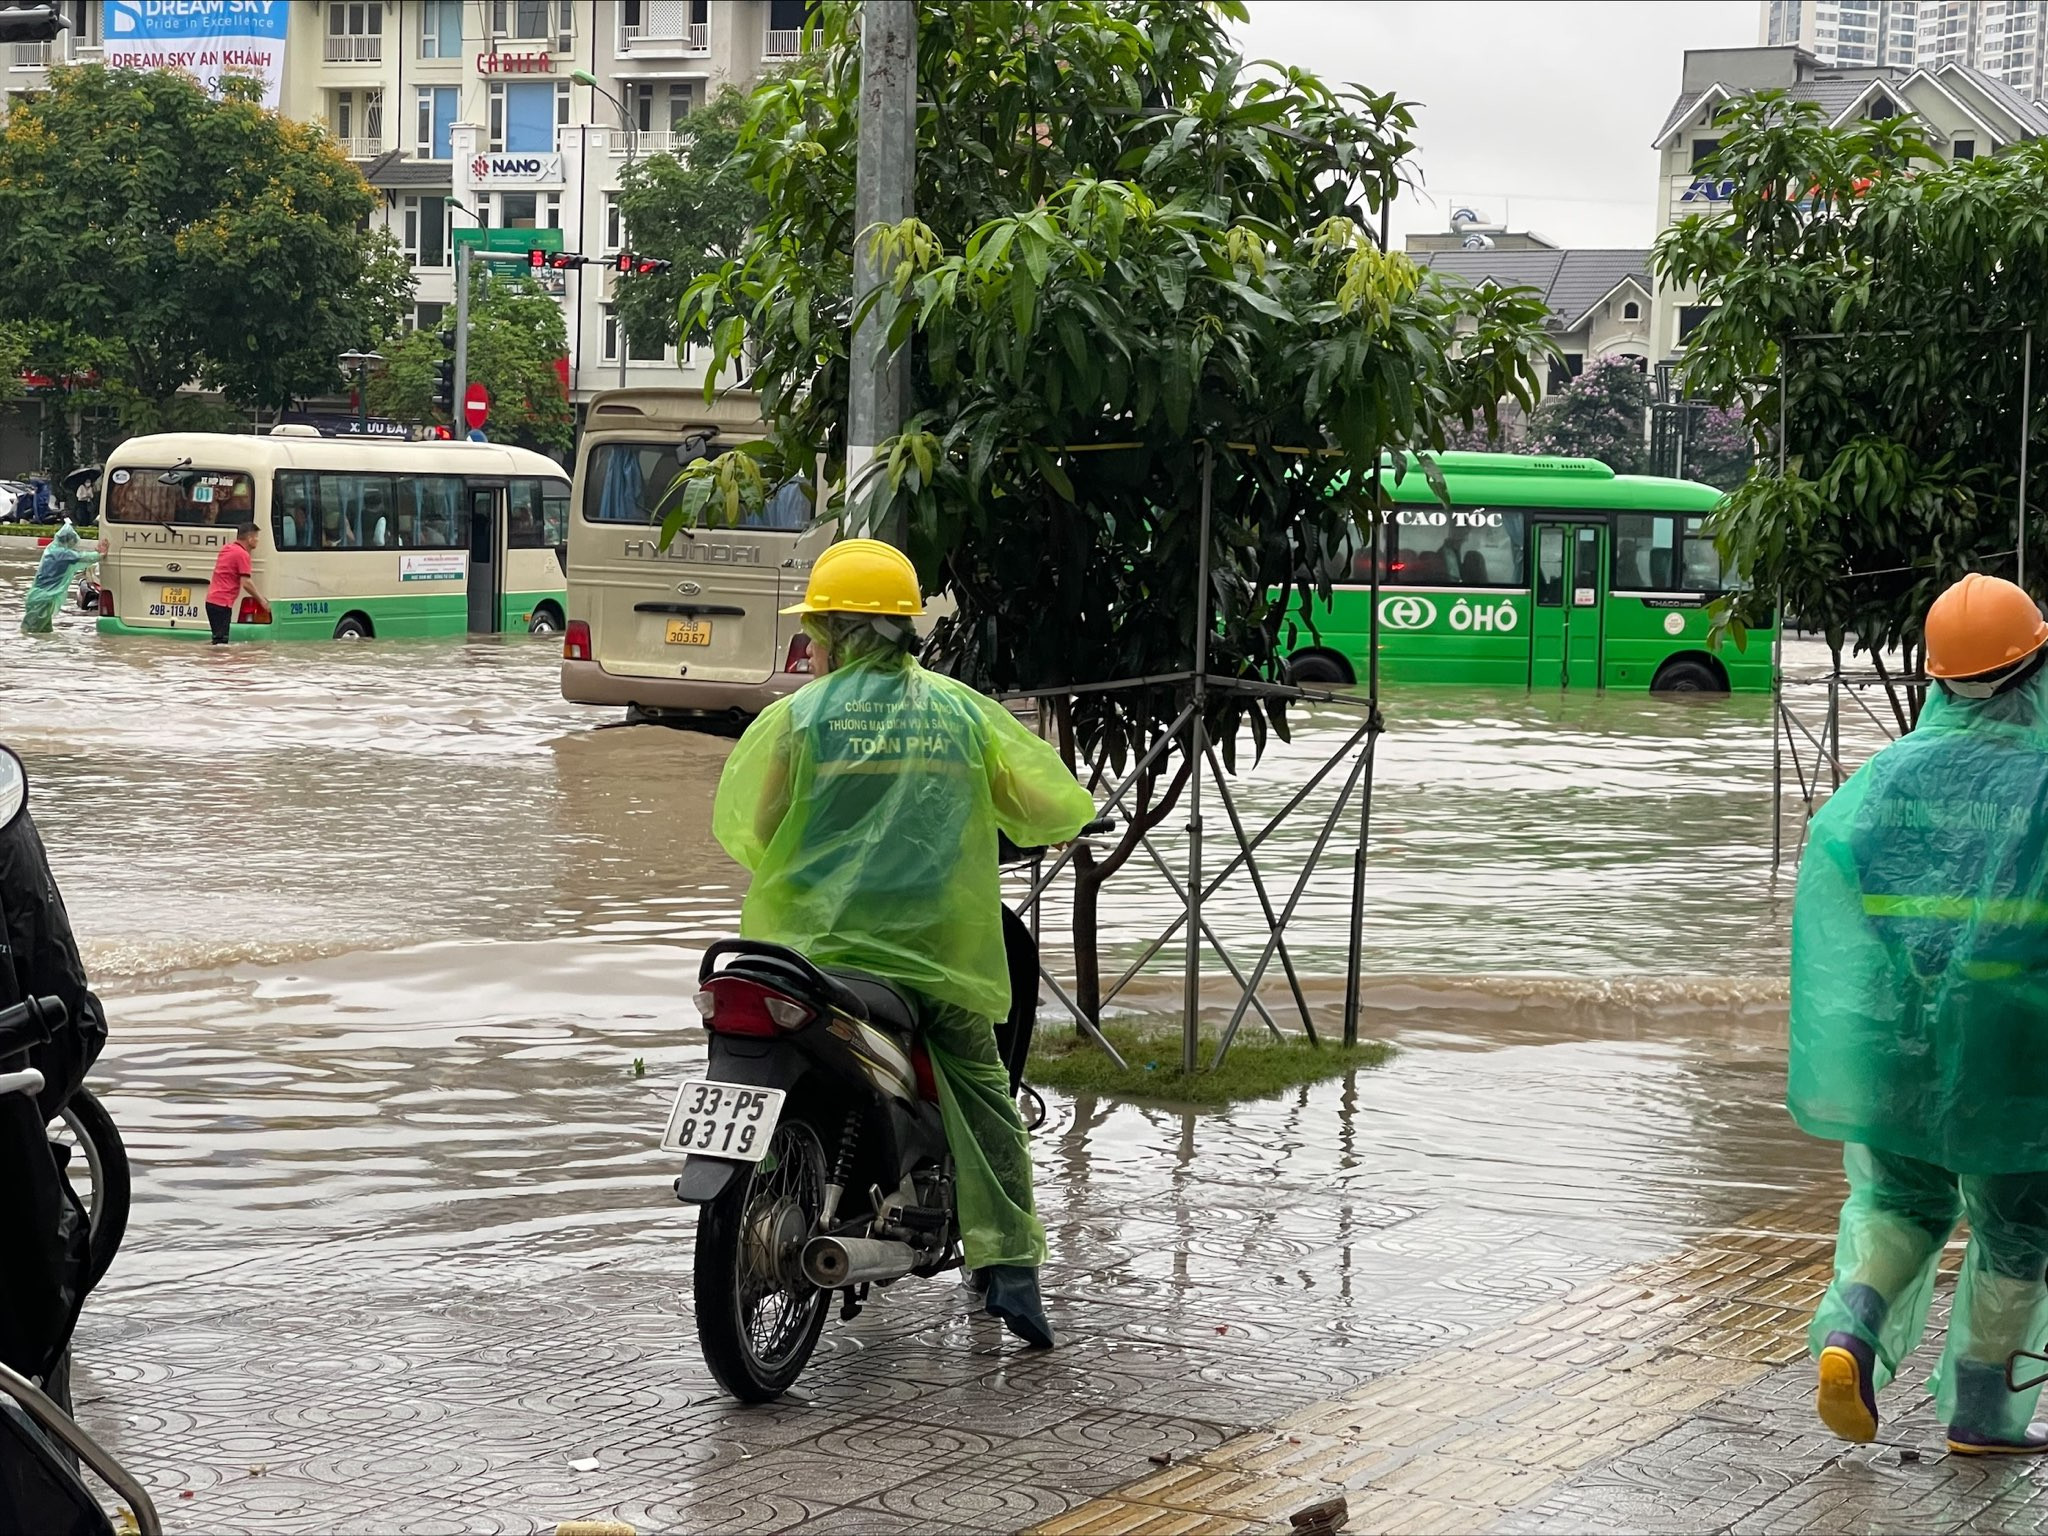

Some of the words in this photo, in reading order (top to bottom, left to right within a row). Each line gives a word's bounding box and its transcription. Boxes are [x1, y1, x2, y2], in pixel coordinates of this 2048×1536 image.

[146, 1, 223, 16] DREAM
[229, 1, 273, 15] SKY
[146, 18, 179, 30] Pride
[185, 17, 197, 28] in
[203, 15, 274, 29] Excellence
[112, 52, 164, 68] DREAM
[168, 51, 196, 67] SKY
[199, 51, 219, 66] AN
[223, 46, 272, 67] KHÁNH
[196, 487, 210, 502] 01
[1395, 510, 1447, 527] CAO
[1452, 507, 1503, 528] TỐC
[125, 531, 227, 546] HYUNDAI
[624, 539, 761, 564] HYUNDAI
[150, 604, 198, 618] 29B-119.48
[290, 602, 329, 614] 29B-119.48
[1649, 600, 1680, 608] THACO
[1449, 597, 1518, 632] ÔHÔ
[679, 621, 699, 632] 29B
[670, 632, 705, 644] 303.67
[844, 698, 872, 713] CÔNG
[874, 702, 885, 713] TY
[828, 718, 868, 732] THƯƠNG
[689, 1086, 768, 1122] 33-P5
[678, 1117, 757, 1153] 8319
